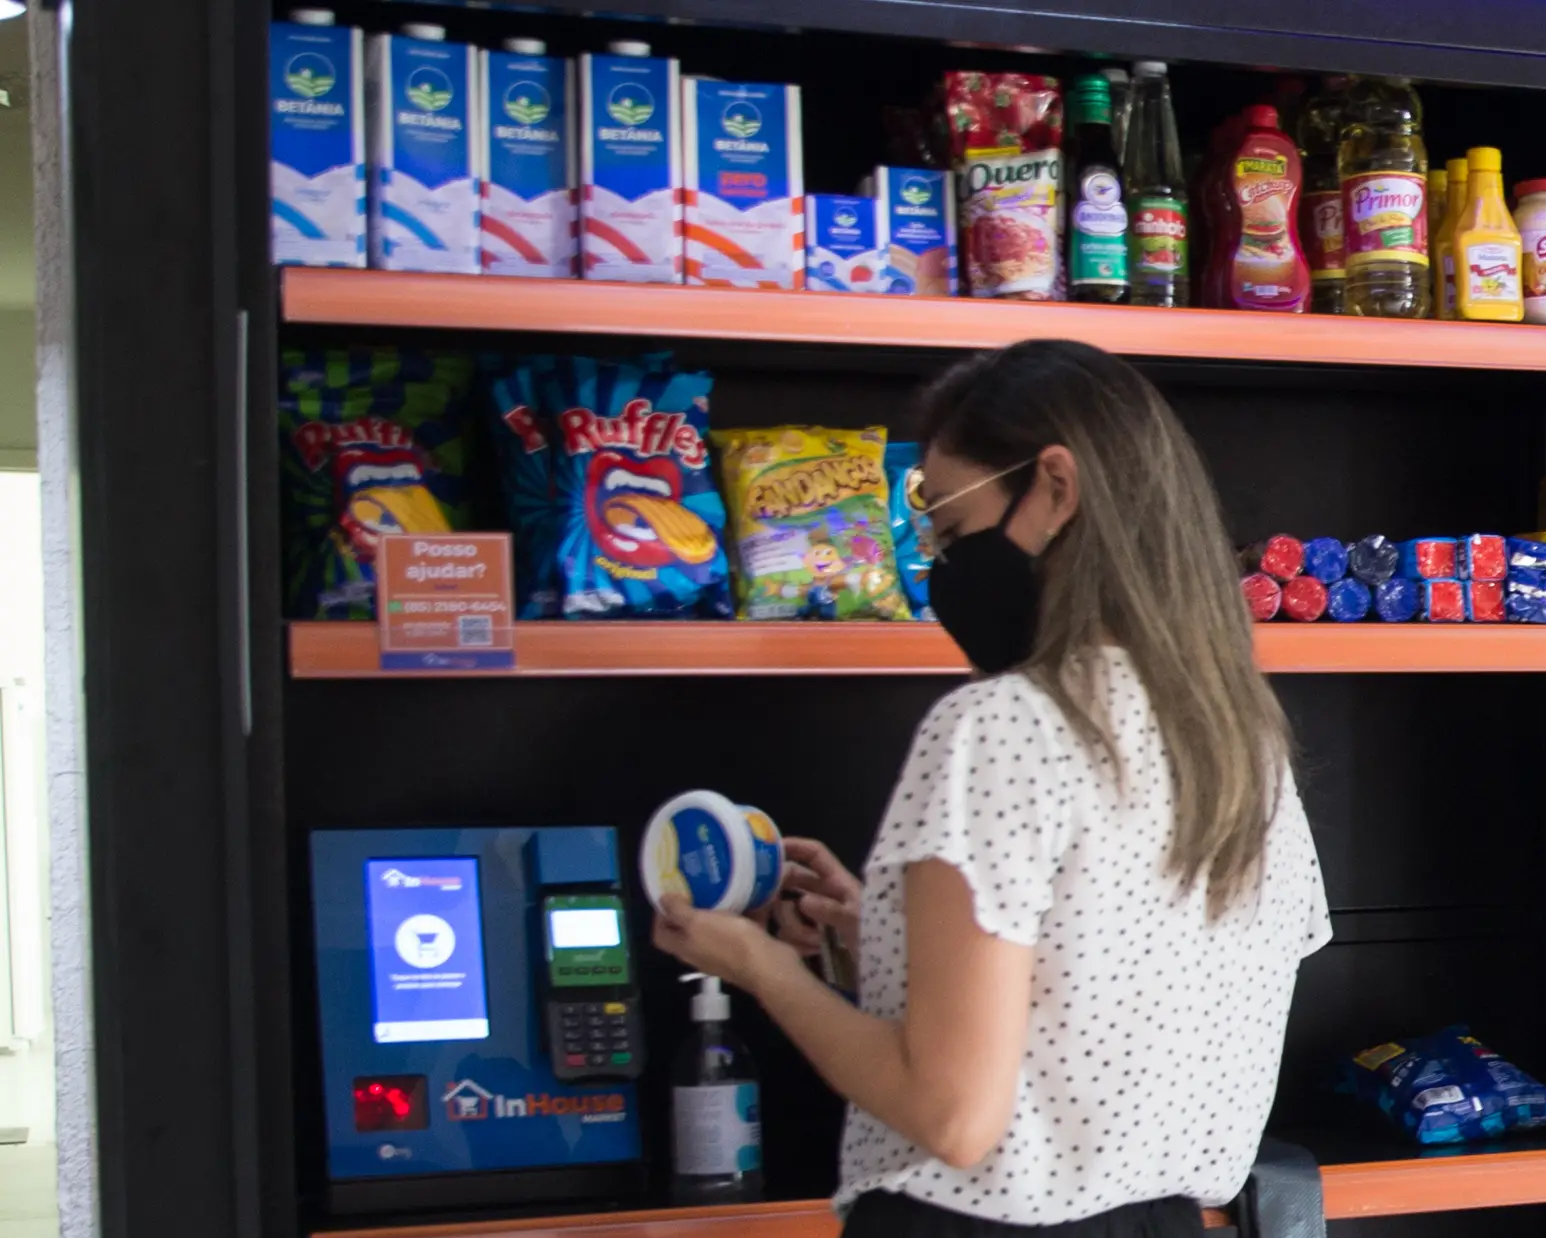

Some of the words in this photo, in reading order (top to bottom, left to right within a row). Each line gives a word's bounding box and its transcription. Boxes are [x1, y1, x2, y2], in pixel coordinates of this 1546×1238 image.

[1355, 186, 1420, 213] Primor
[557, 398, 709, 469] Ruffles
[412, 541, 477, 557] Posso
[405, 562, 487, 582] ajudar?
[494, 1092, 626, 1119] InHouse
